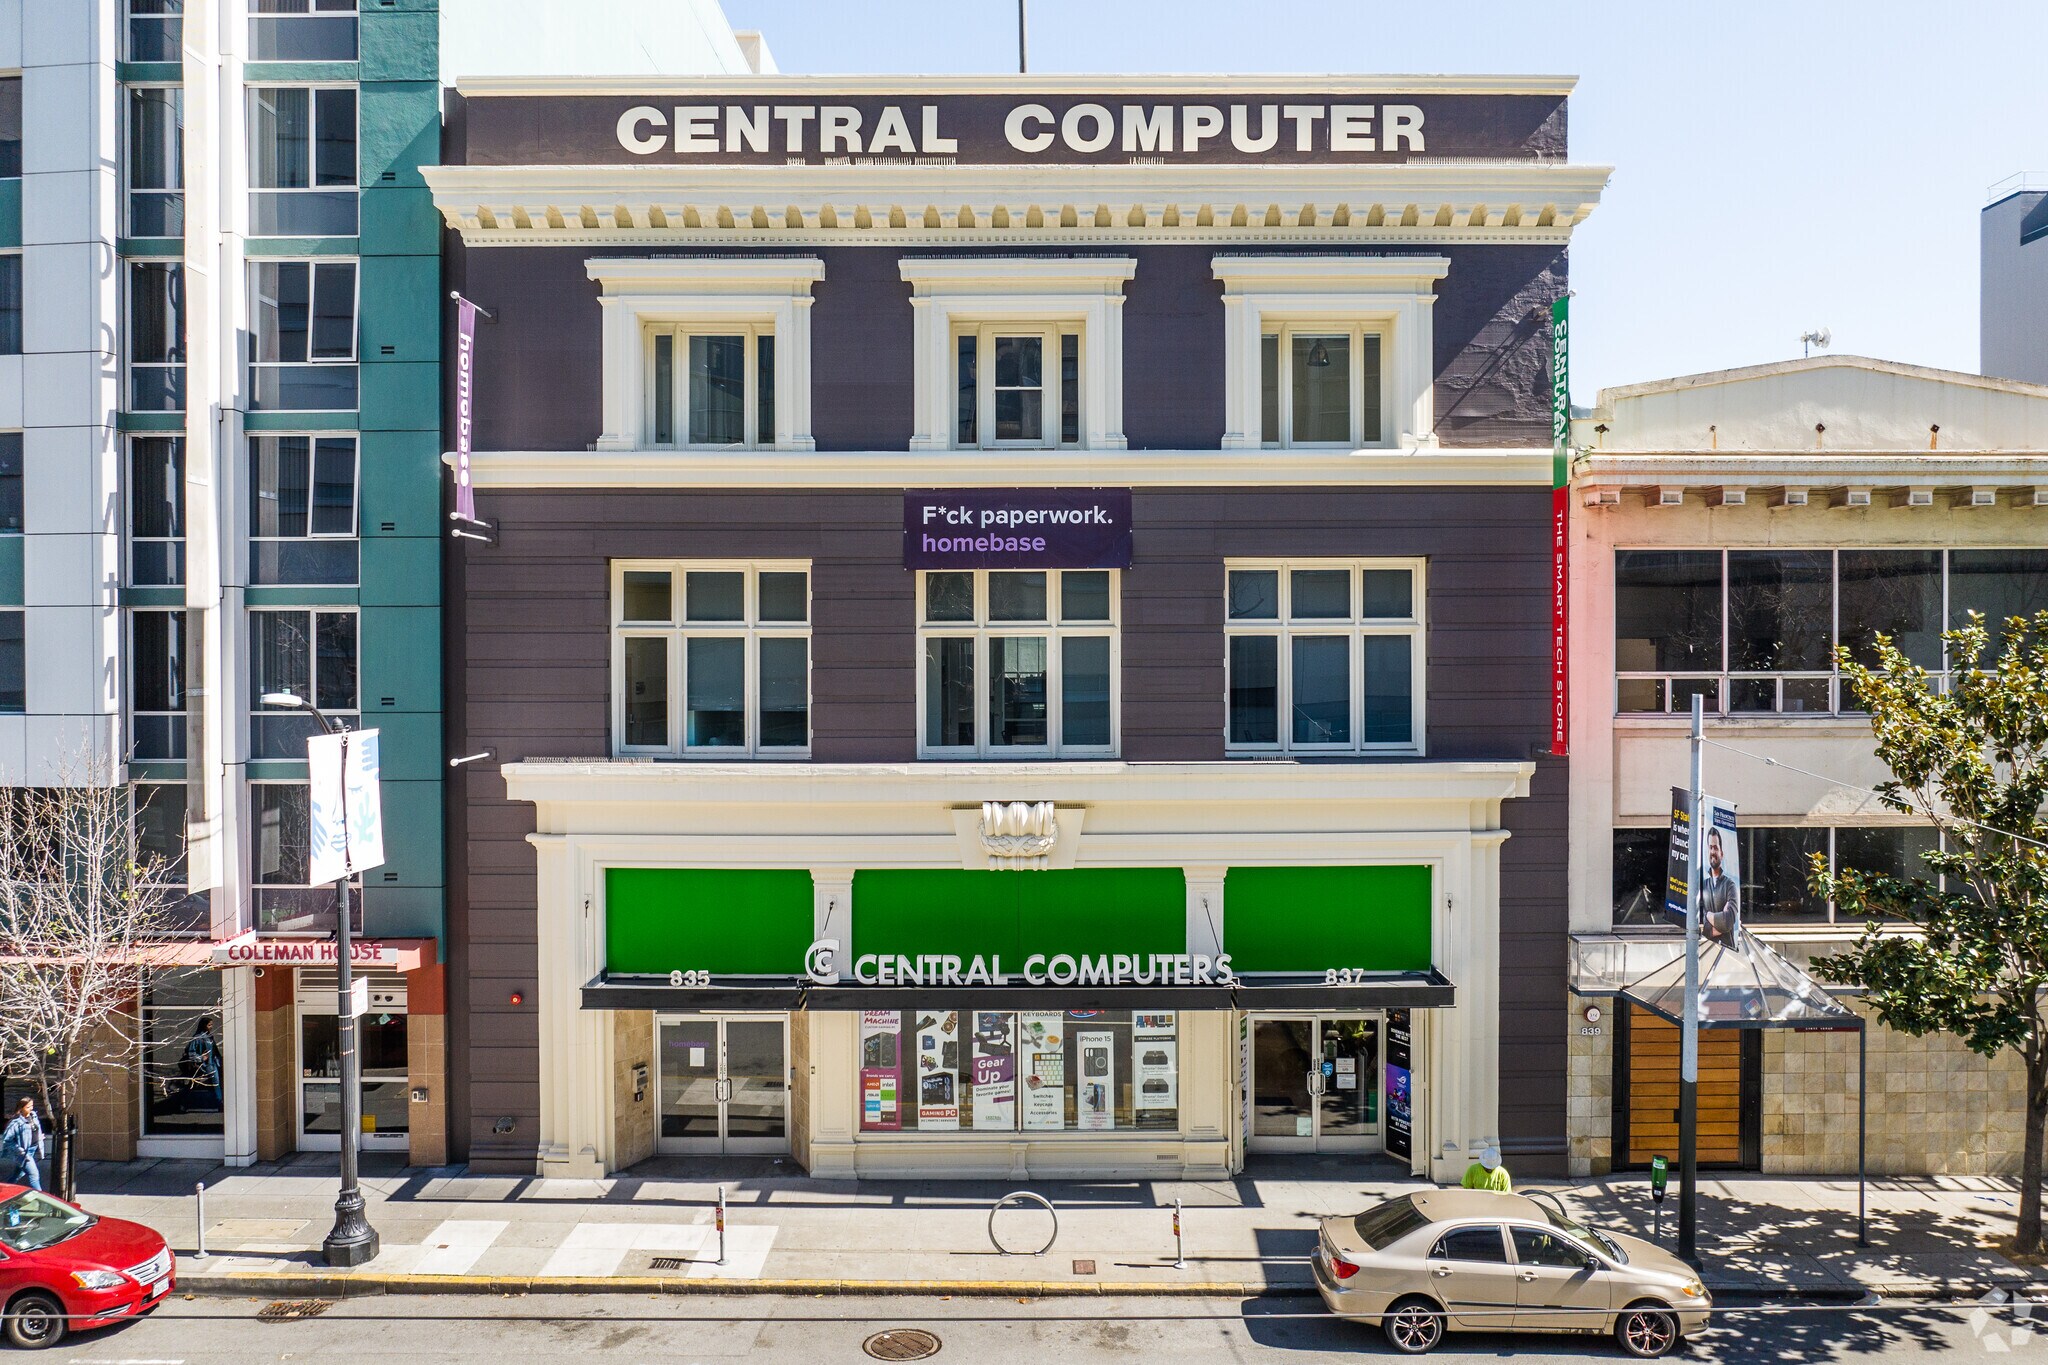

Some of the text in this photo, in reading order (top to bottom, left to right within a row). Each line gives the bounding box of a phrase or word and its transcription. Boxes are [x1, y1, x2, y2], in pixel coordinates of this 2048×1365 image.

[616, 103, 1425, 155] CENTRAL COMPUTER
[1559, 319, 1567, 447] CENTRAL
[980, 505, 1113, 528] paperwork.
[922, 533, 1046, 552] homebase
[228, 944, 382, 960] COLEMAN HUSE
[854, 954, 1008, 986] CENTRAL
[1023, 953, 1234, 986] COMPUTERS
[1325, 968, 1365, 986] 837
[670, 970, 710, 987] 835
[864, 1017, 899, 1025] MACHINE
[1581, 1027, 1601, 1036] 839
[668, 1040, 709, 1048] homebase
[978, 1058, 1005, 1069] Gear
[978, 1070, 1001, 1084] Up
